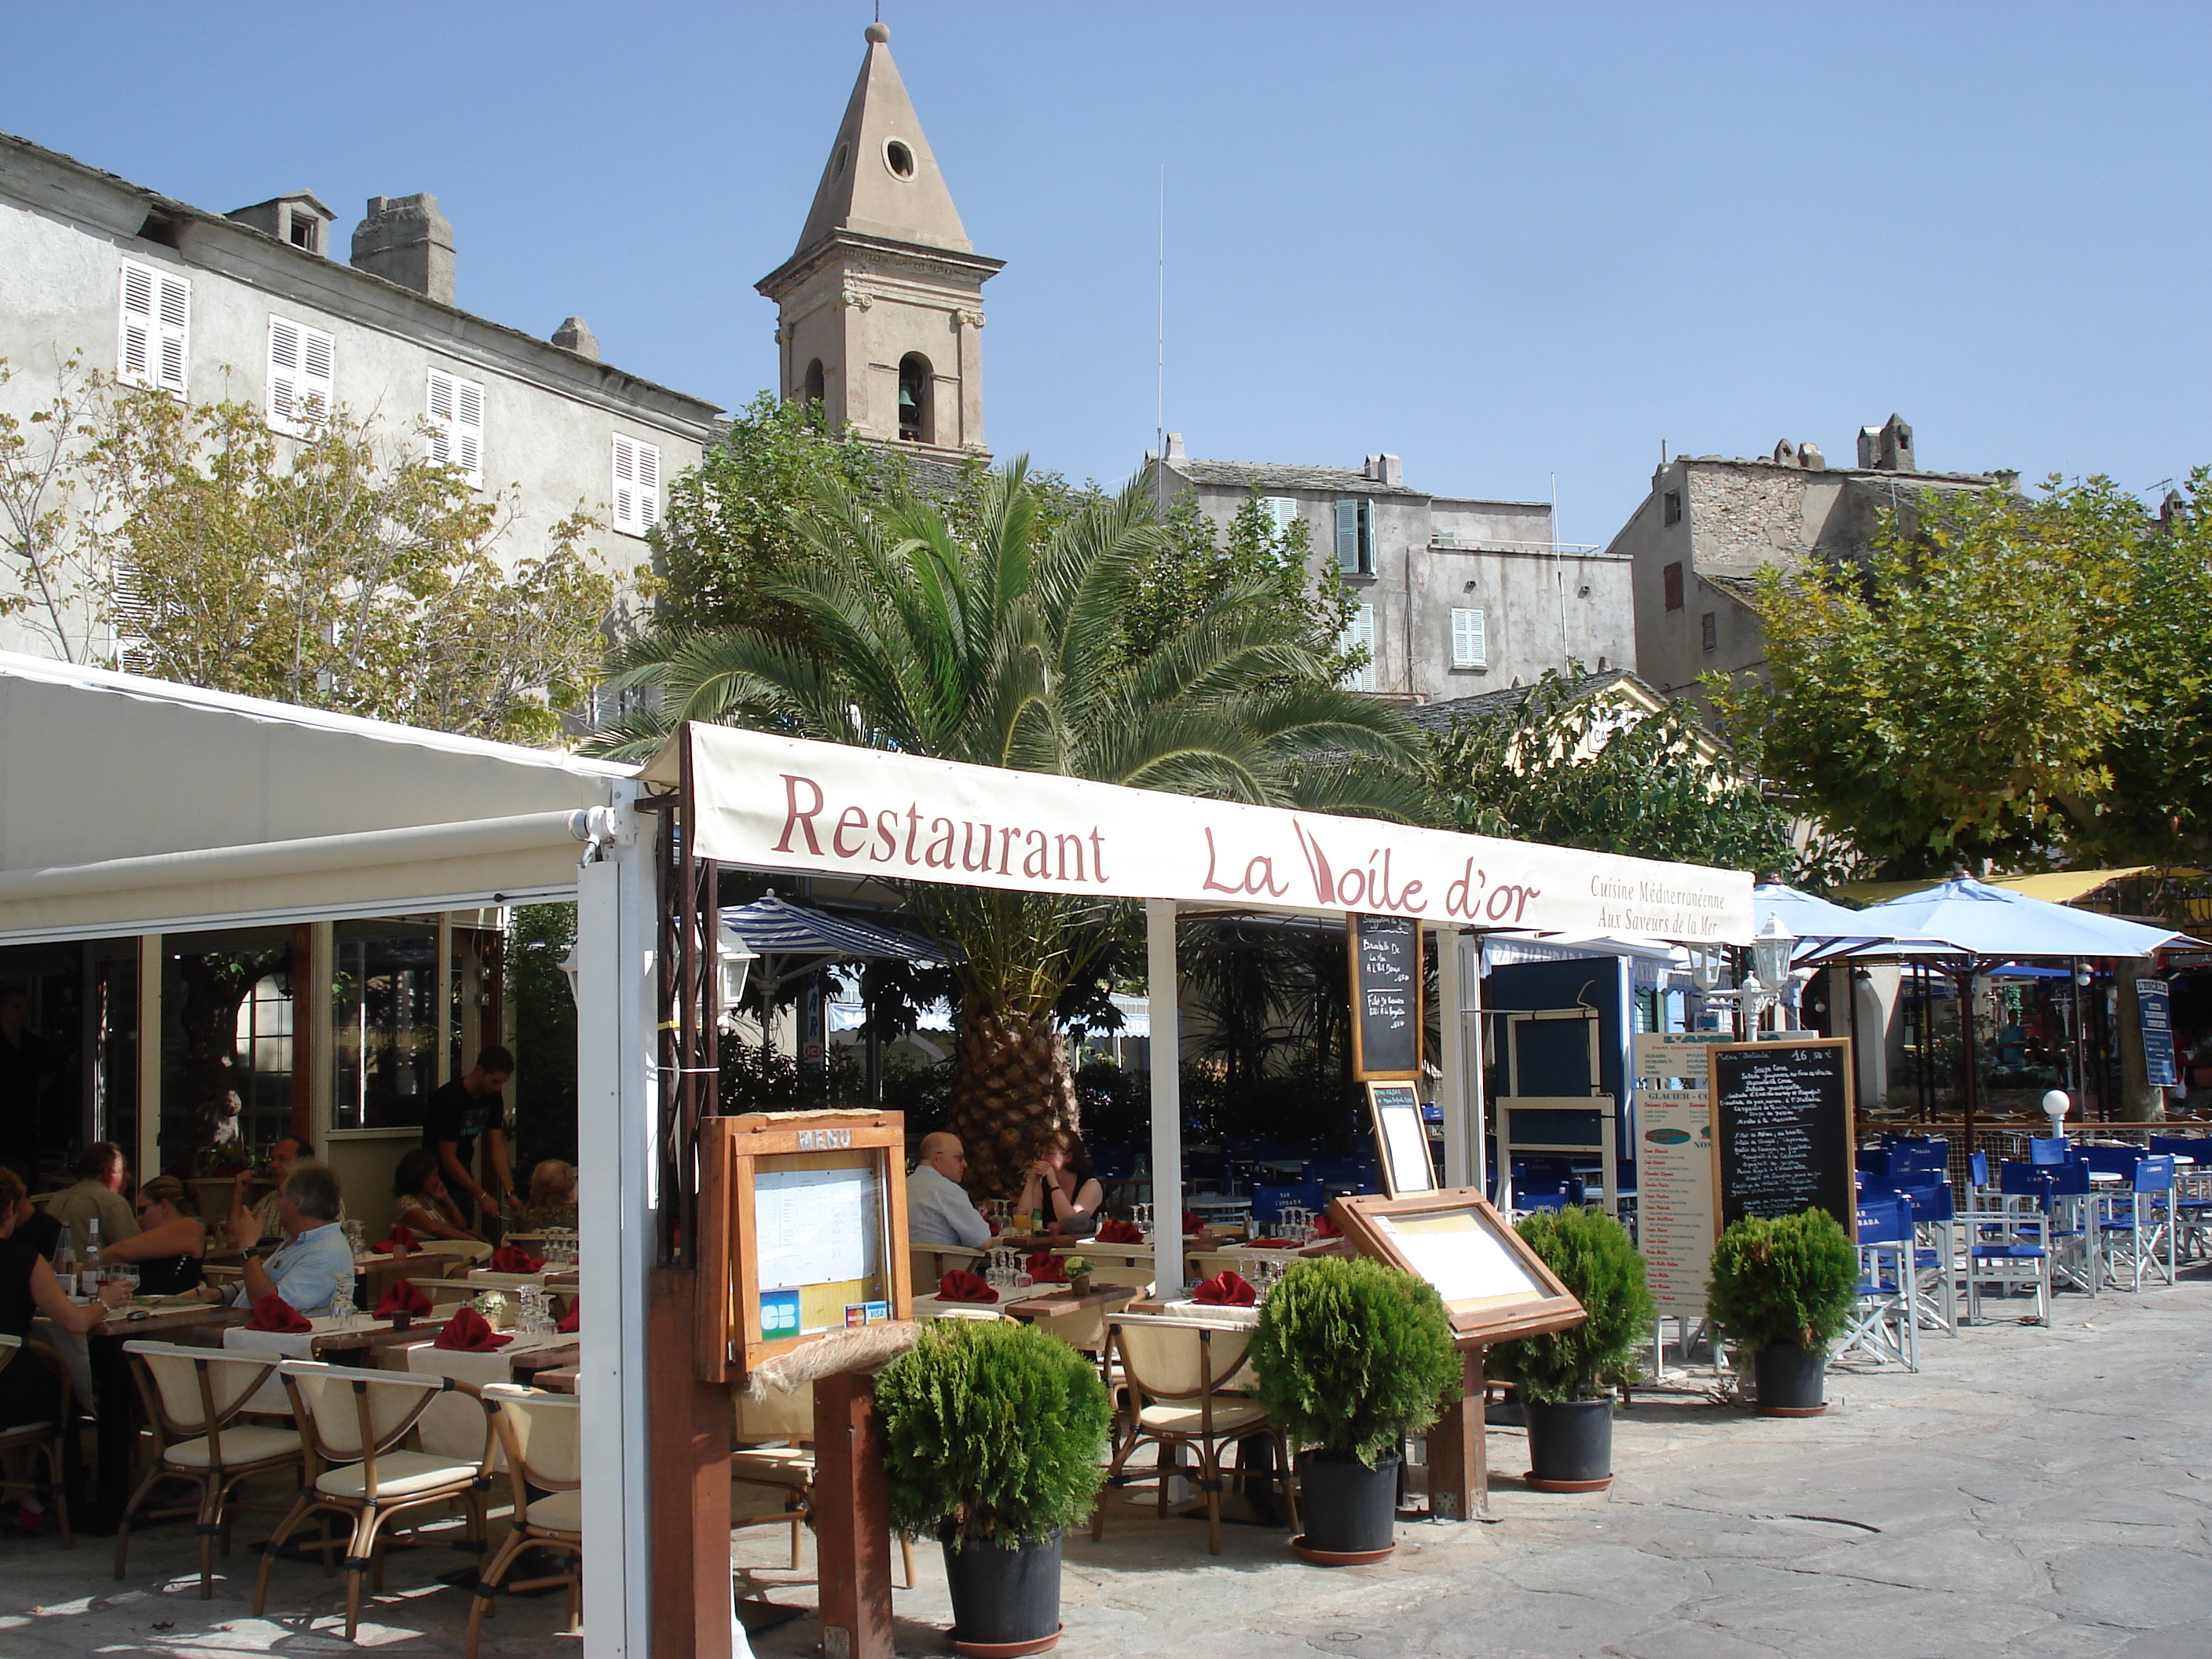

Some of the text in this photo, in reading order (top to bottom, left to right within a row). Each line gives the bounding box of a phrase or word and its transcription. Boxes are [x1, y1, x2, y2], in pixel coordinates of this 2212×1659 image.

[771, 774, 1109, 884] Restaurant
[1203, 827, 1289, 897] La
[1446, 856, 1540, 922] d'or
[1591, 875, 1725, 910] Cuisine Méditerranéenne
[1598, 906, 1718, 936] Aux Saveurs de la Mer
[799, 1130, 851, 1151] MENU
[870, 1309, 884, 1318] VISA
